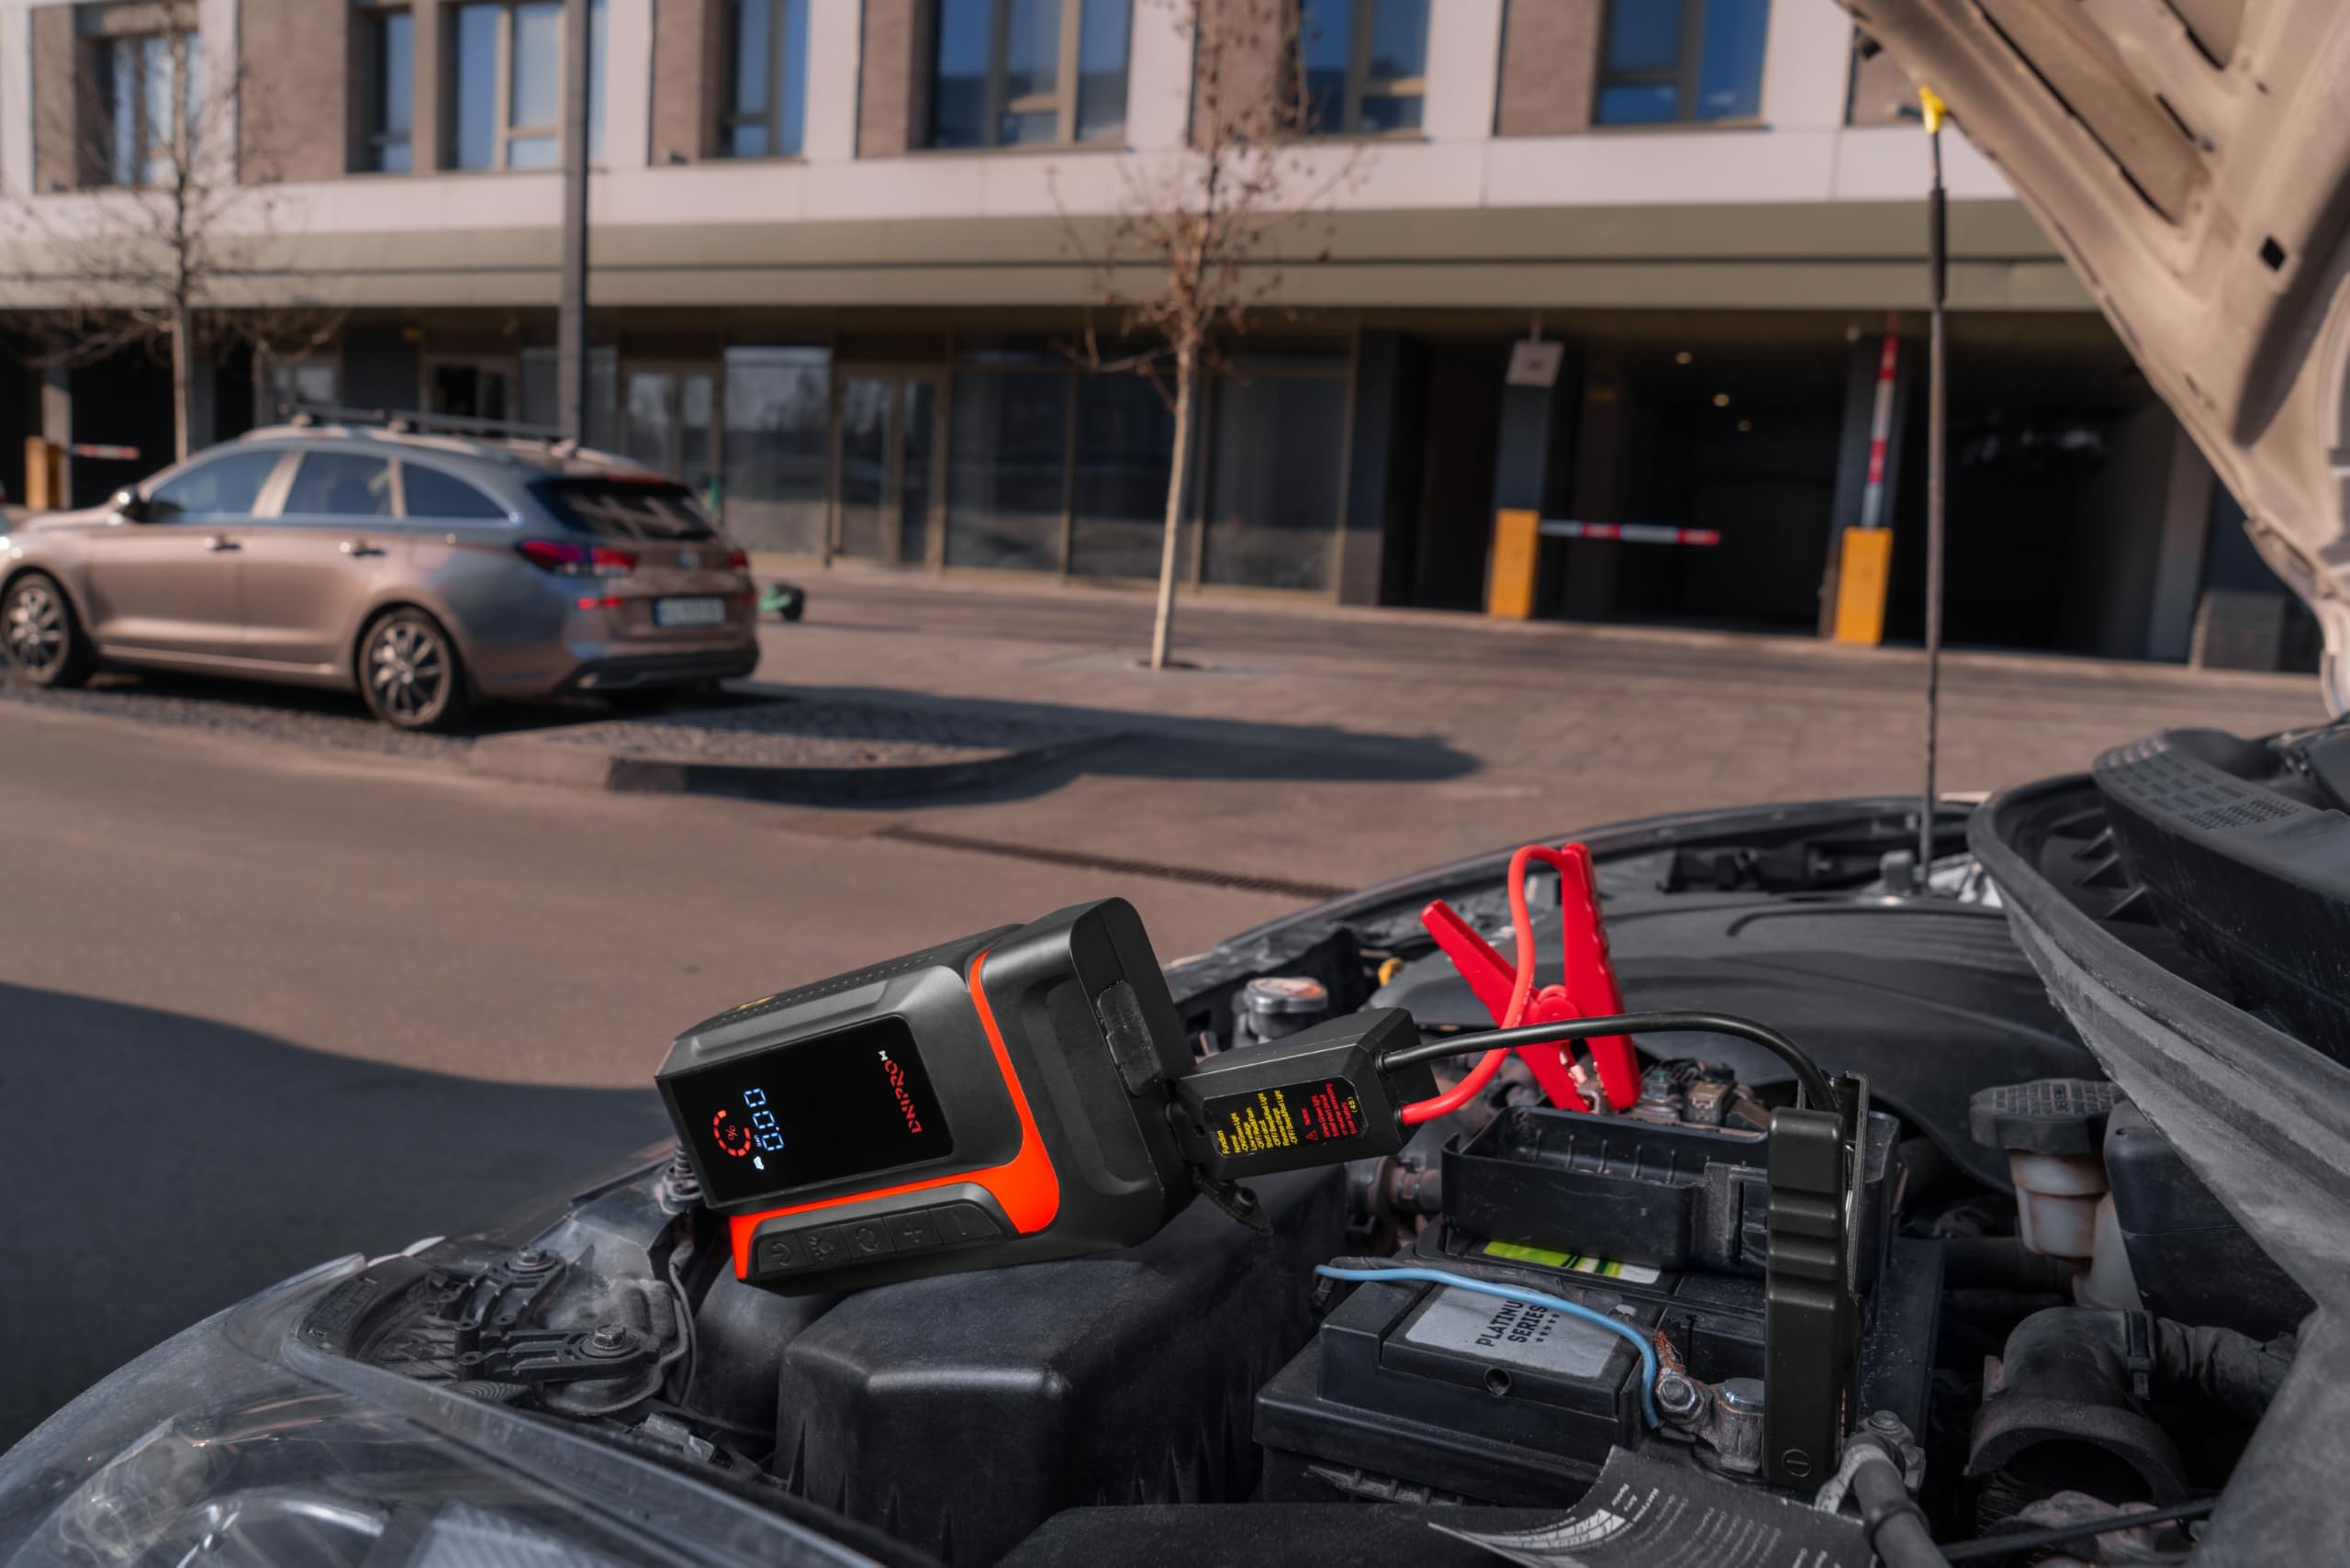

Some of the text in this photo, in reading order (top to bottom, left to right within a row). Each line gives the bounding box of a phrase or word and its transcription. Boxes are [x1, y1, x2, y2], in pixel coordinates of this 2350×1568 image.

[743, 1088, 785, 1151] 0.00
[1217, 1130, 1230, 1154] Function
[1231, 1135, 1241, 1153] Normal
[1243, 1122, 1258, 1151] Low voltage
[1264, 1135, 1273, 1148] Short
[1279, 1125, 1290, 1146] Reverse
[1475, 1299, 1525, 1347] PLATINU
[1506, 1305, 1549, 1342] SERIES
